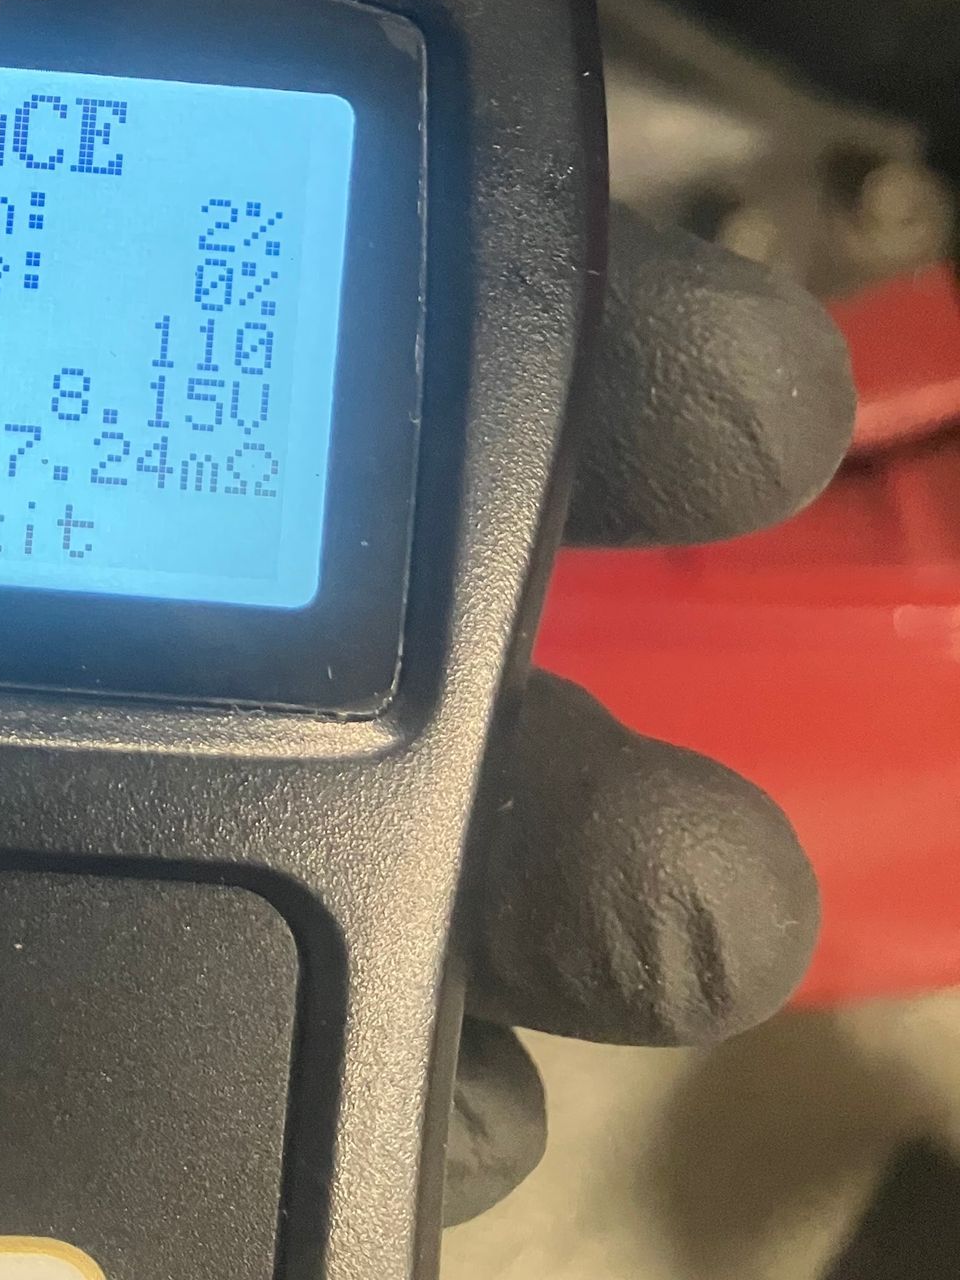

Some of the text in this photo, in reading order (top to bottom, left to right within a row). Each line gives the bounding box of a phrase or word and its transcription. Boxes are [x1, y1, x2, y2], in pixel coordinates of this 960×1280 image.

[198, 198, 283, 257] 2%
[194, 258, 279, 316] 0%
[152, 315, 274, 375] 110
[51, 367, 269, 436] 8.15V
